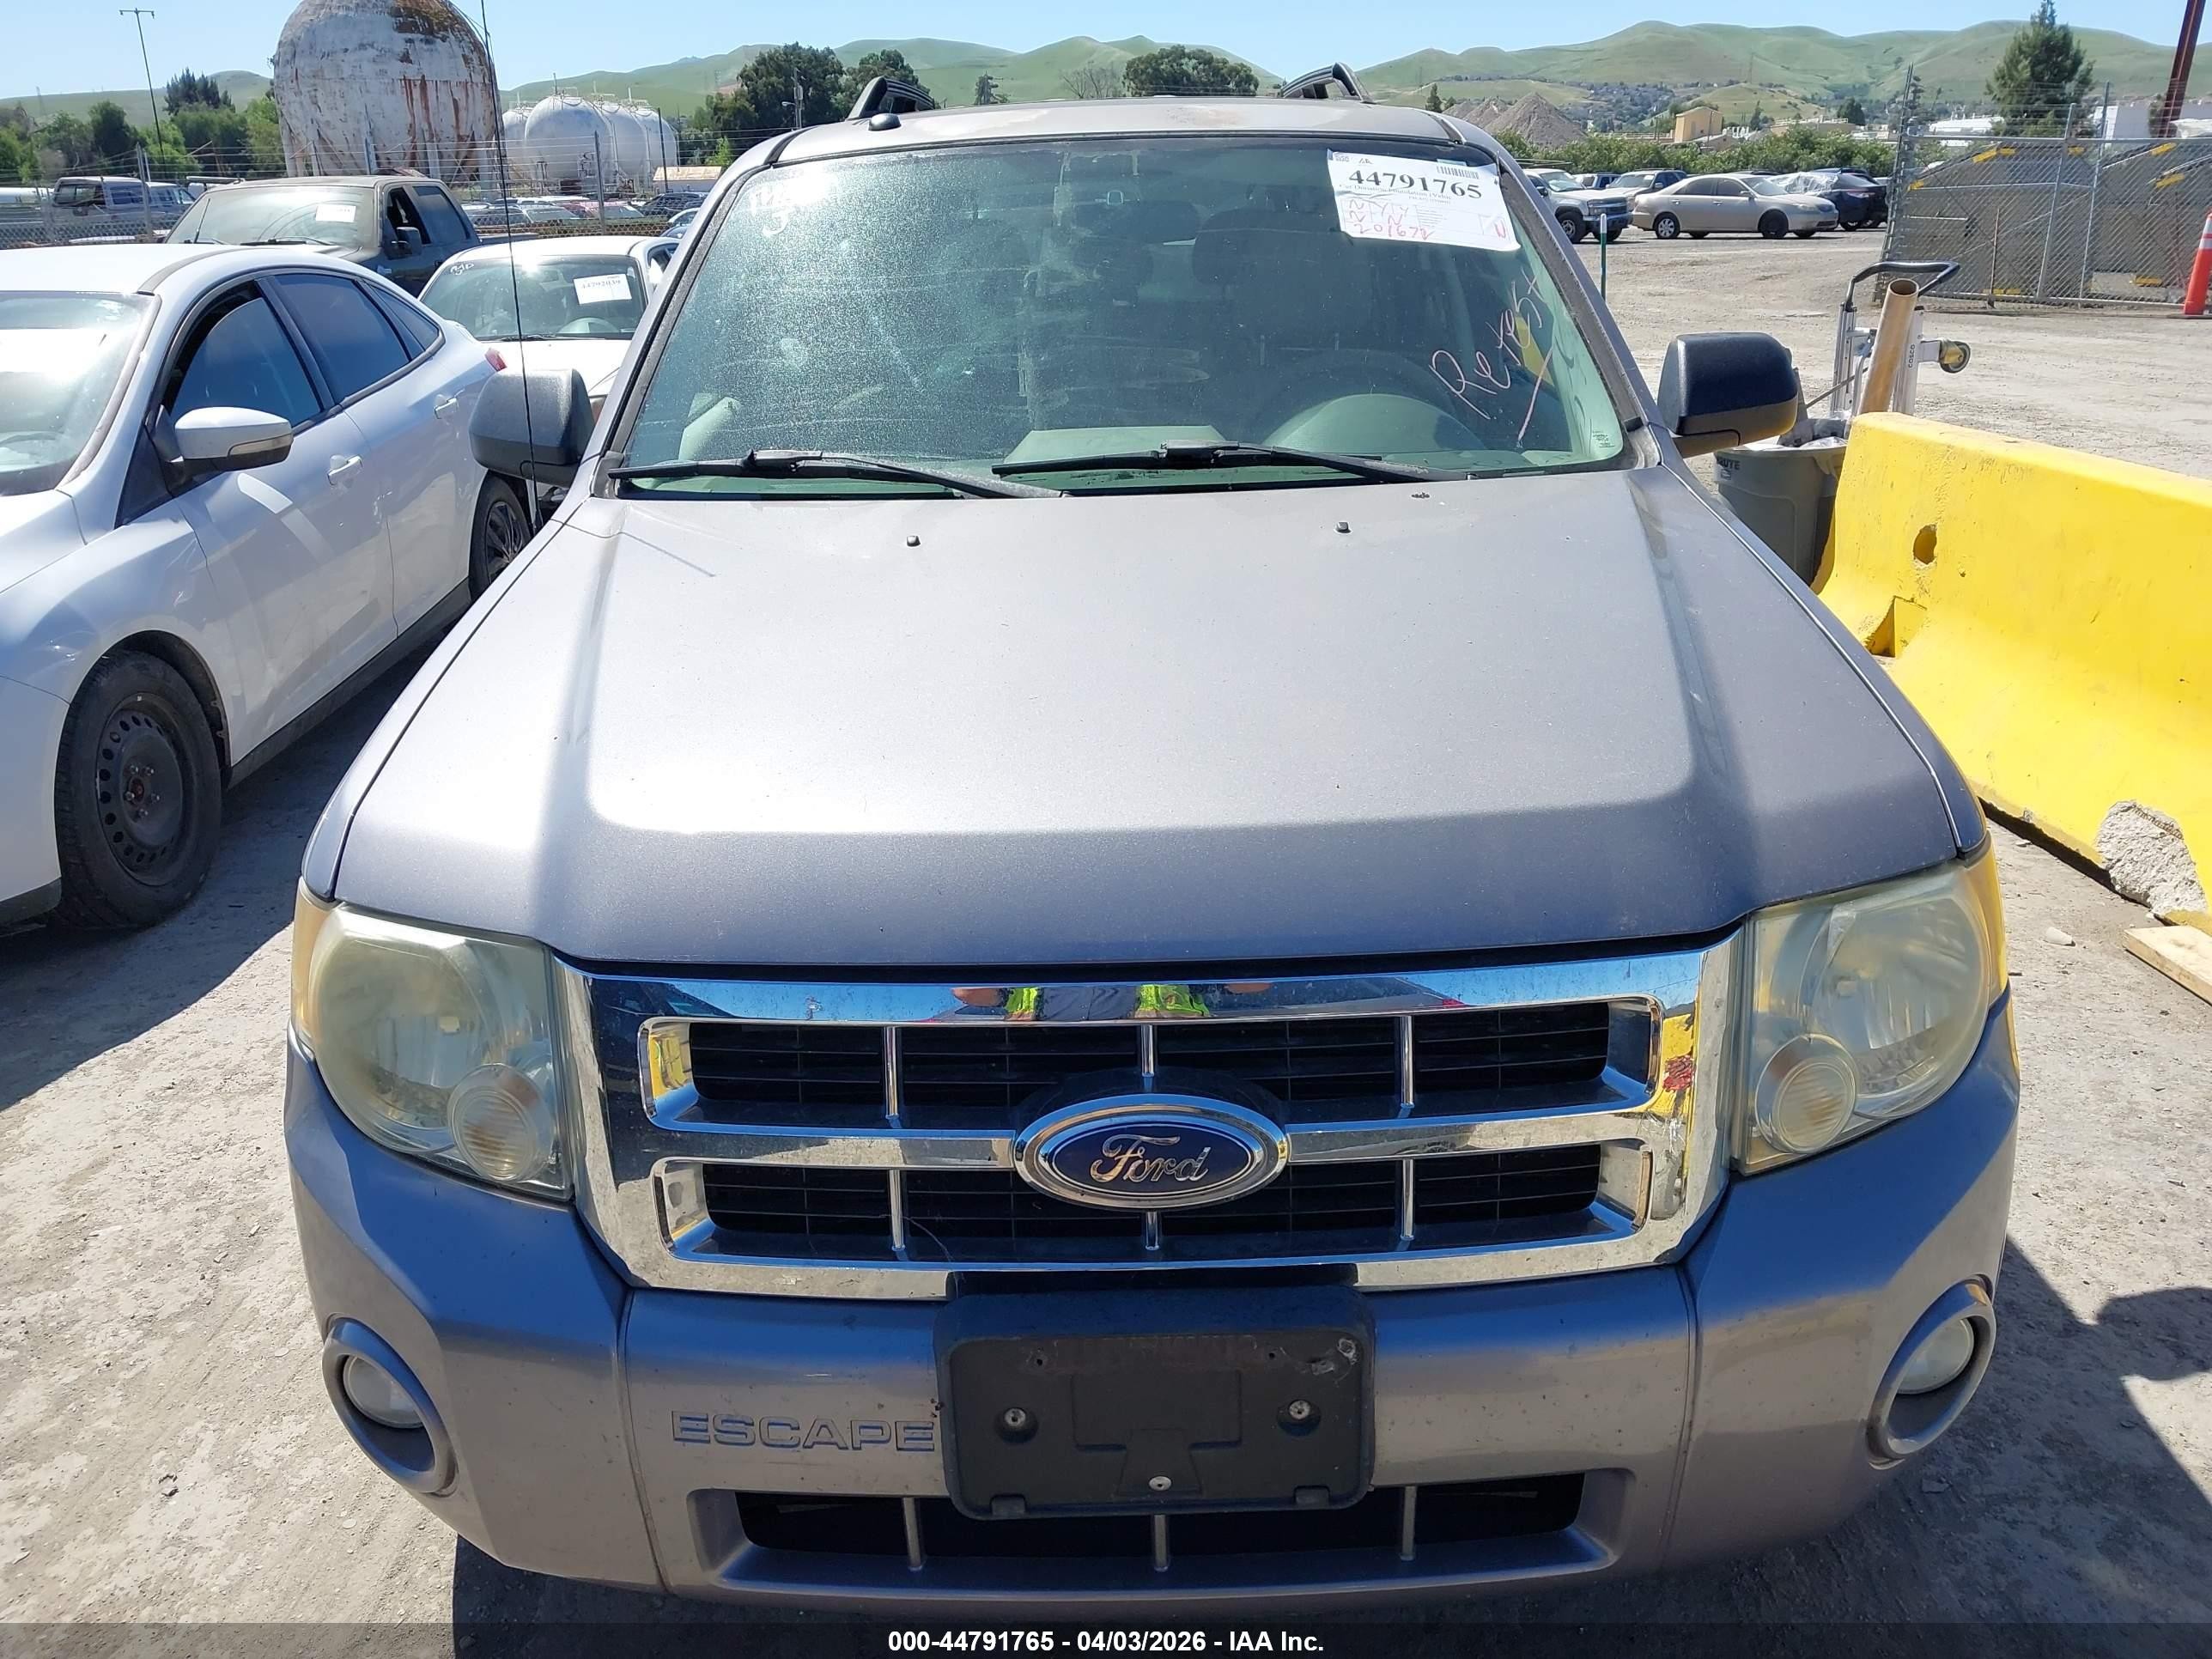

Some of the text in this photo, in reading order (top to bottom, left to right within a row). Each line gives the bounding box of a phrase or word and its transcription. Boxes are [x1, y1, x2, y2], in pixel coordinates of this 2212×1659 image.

[1349, 170, 1482, 198] 44791765
[1090, 1133, 1212, 1182] Ford
[671, 1411, 935, 1452] ESCAPE
